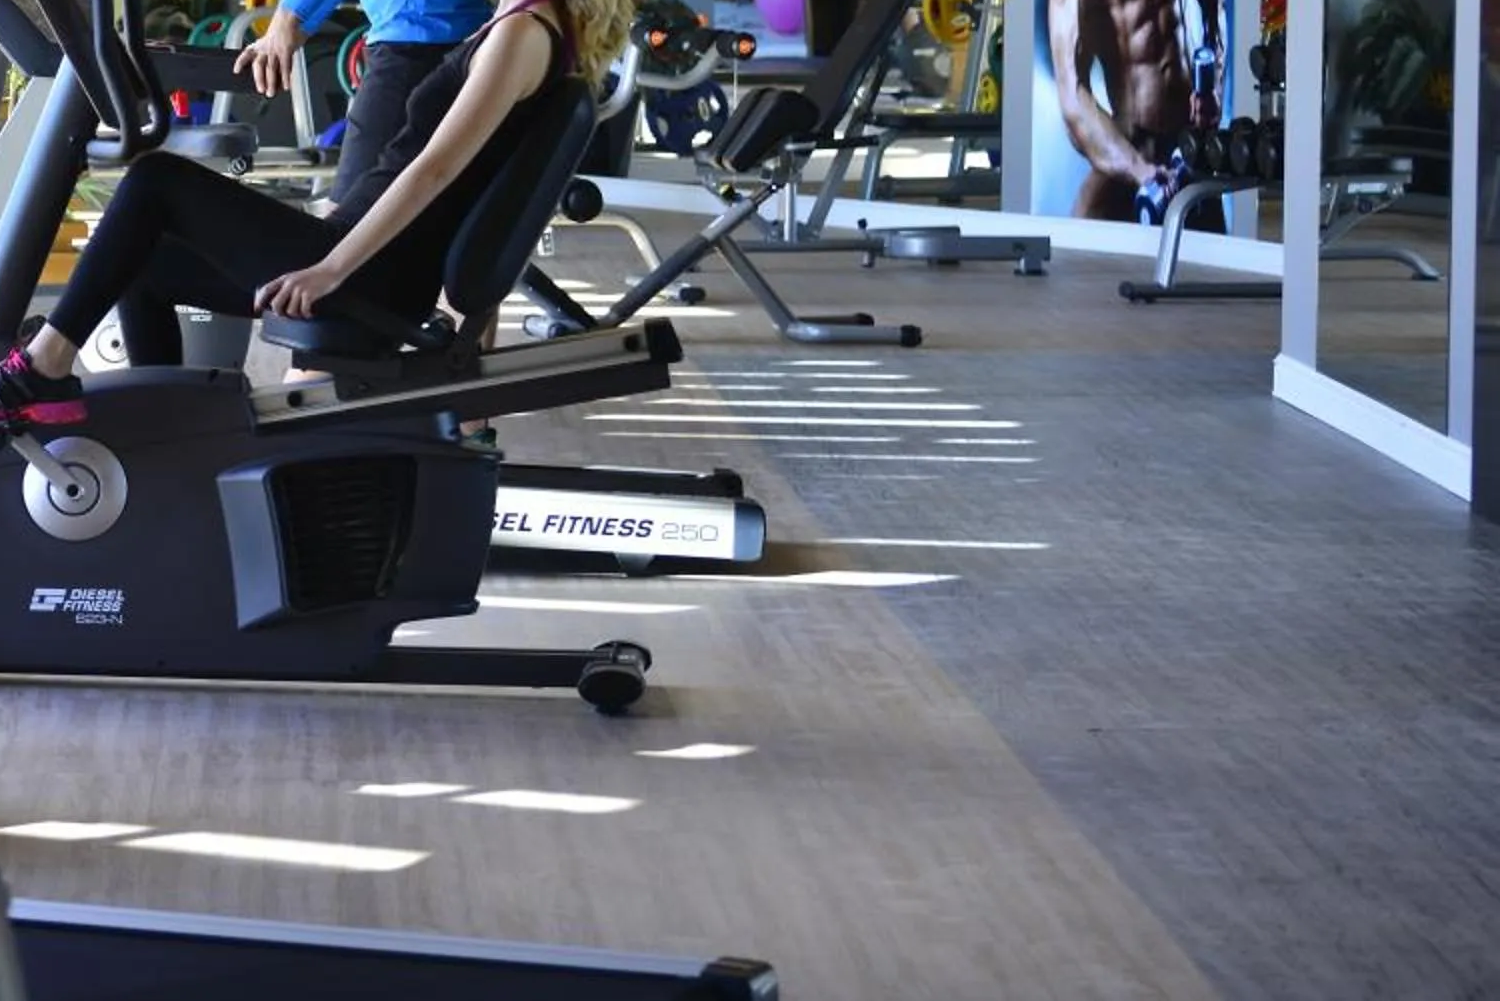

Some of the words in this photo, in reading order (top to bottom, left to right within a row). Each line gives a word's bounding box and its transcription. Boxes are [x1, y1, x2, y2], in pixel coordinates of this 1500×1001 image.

[542, 514, 653, 538] FITNESS
[660, 522, 719, 542] 250
[70, 588, 125, 601] DIESEL
[63, 600, 123, 612] FITNESS
